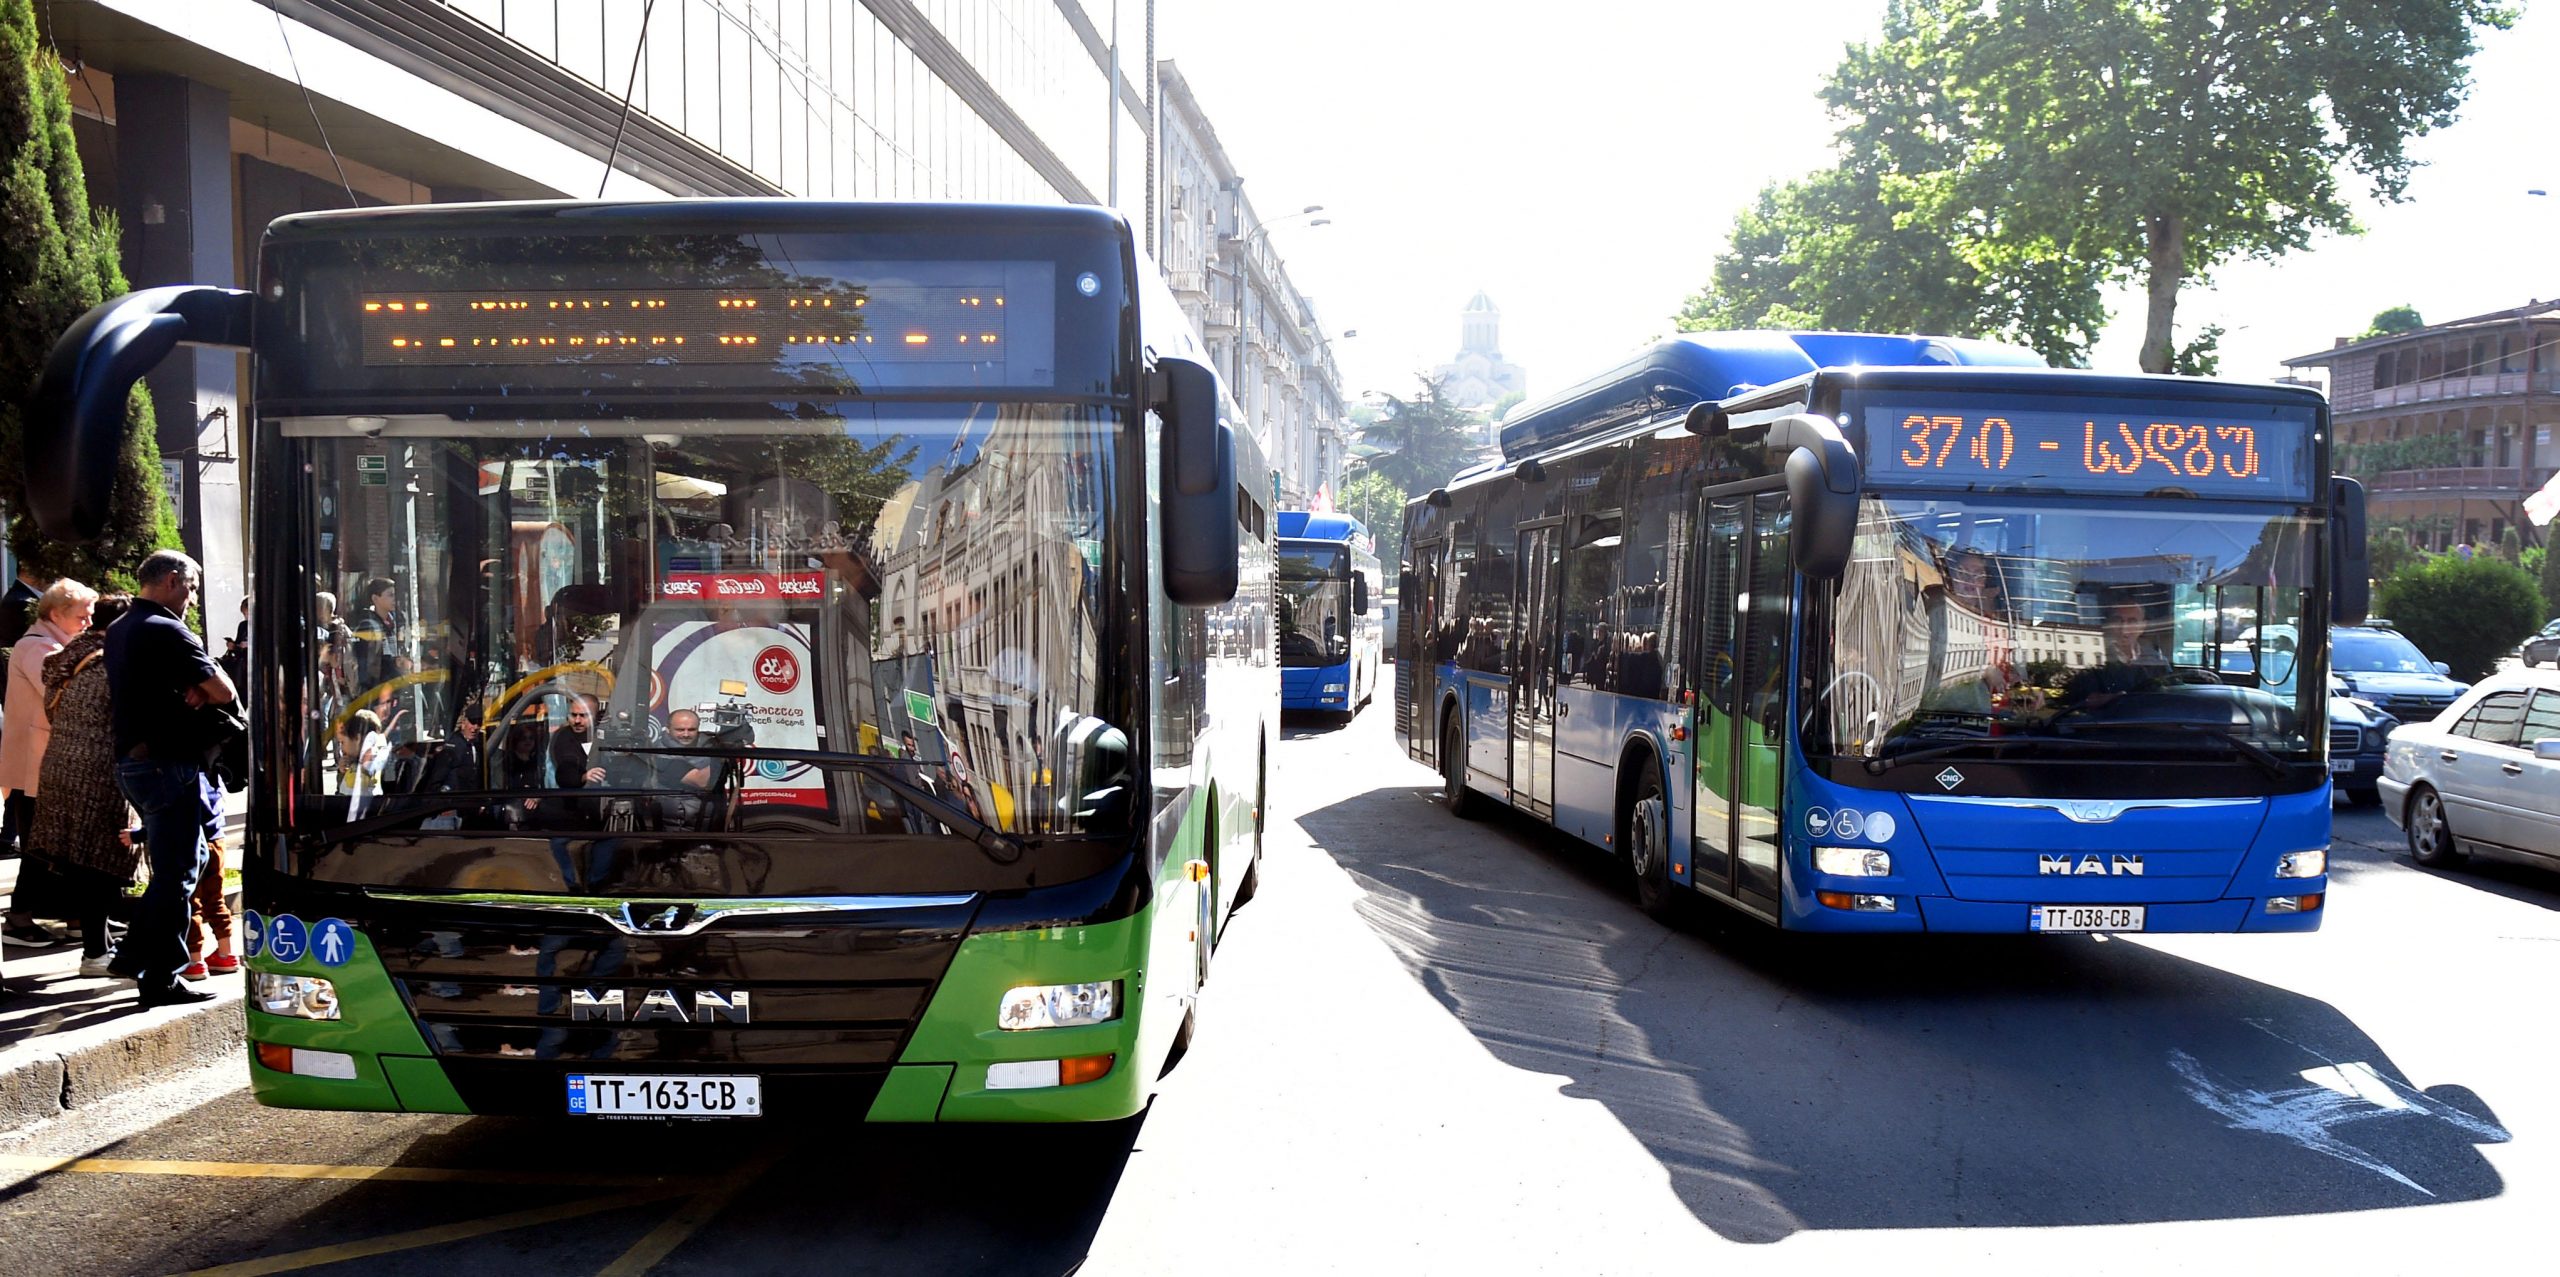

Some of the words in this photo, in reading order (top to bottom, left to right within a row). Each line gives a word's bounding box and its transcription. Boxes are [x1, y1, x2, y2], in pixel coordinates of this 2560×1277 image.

[2083, 421, 2258, 478] სადგუ
[1941, 774, 1959, 782] CNG
[2040, 853, 2144, 876] MAN
[2046, 909, 2131, 928] TT-038-CB
[570, 988, 750, 1024] MAN
[570, 1096, 585, 1109] GE
[590, 1080, 736, 1111] TT-163-CB
